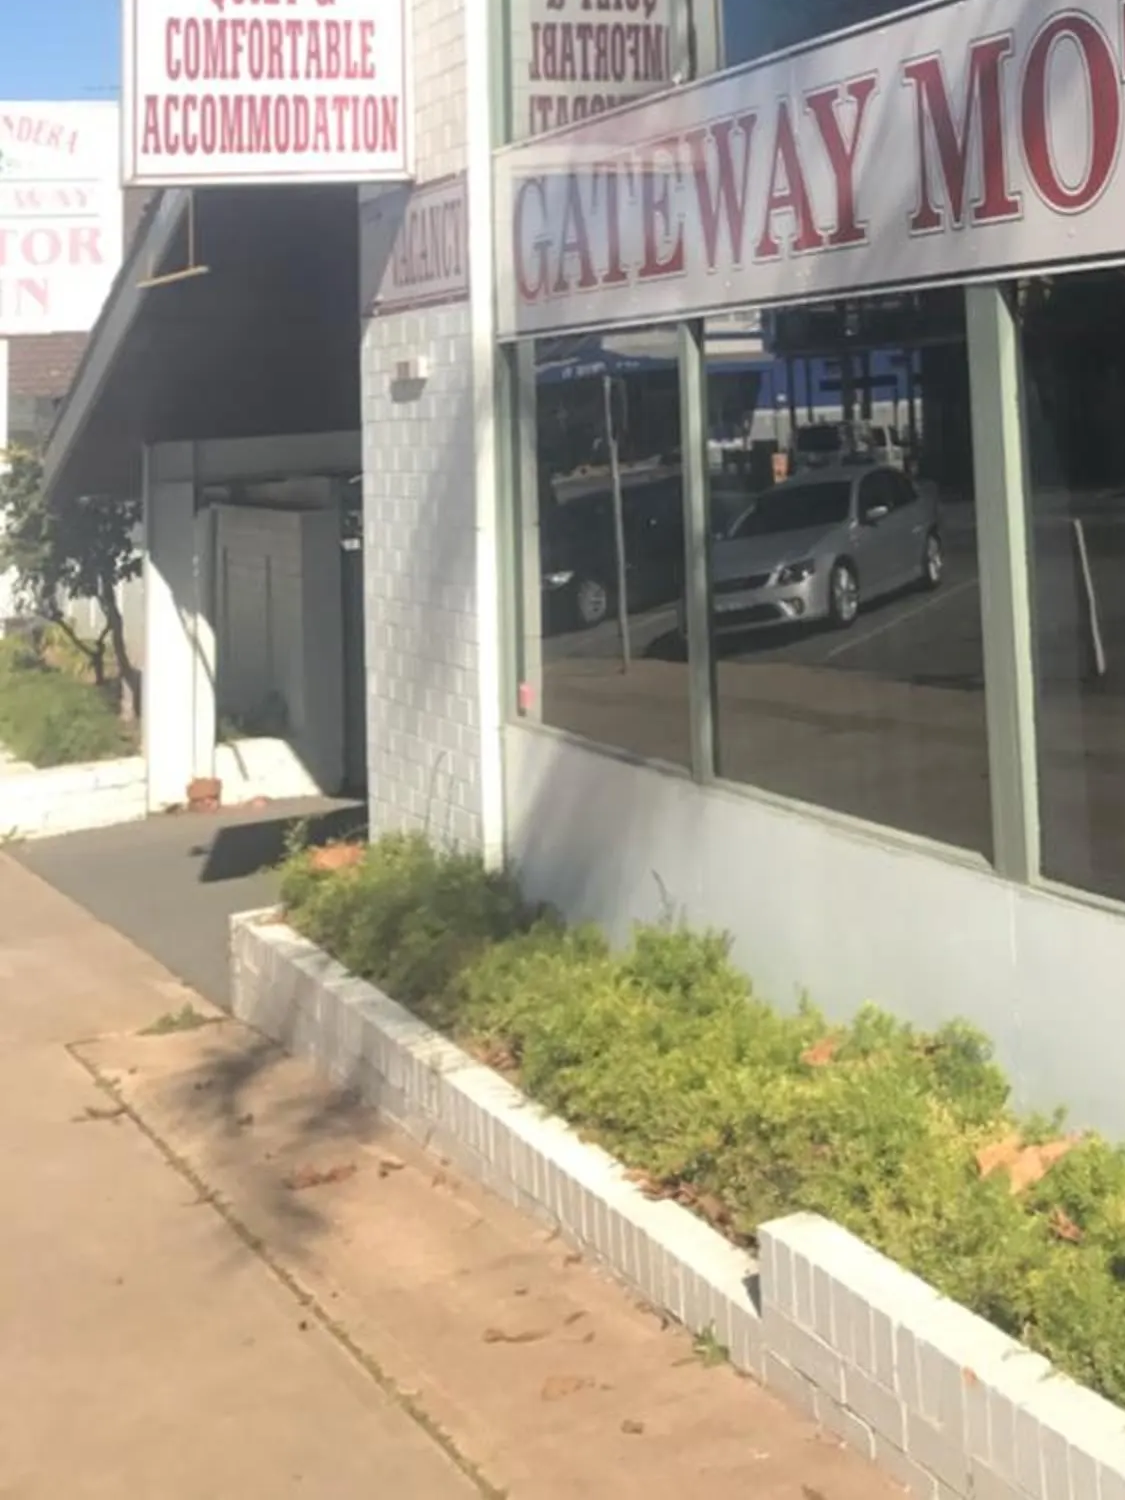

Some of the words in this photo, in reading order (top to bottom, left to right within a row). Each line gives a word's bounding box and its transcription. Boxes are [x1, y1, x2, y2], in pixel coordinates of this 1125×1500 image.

[165, 17, 377, 81] COMFORTABLE
[141, 94, 399, 155] ACCOMMODATION
[512, 68, 882, 304] GATEWAY
